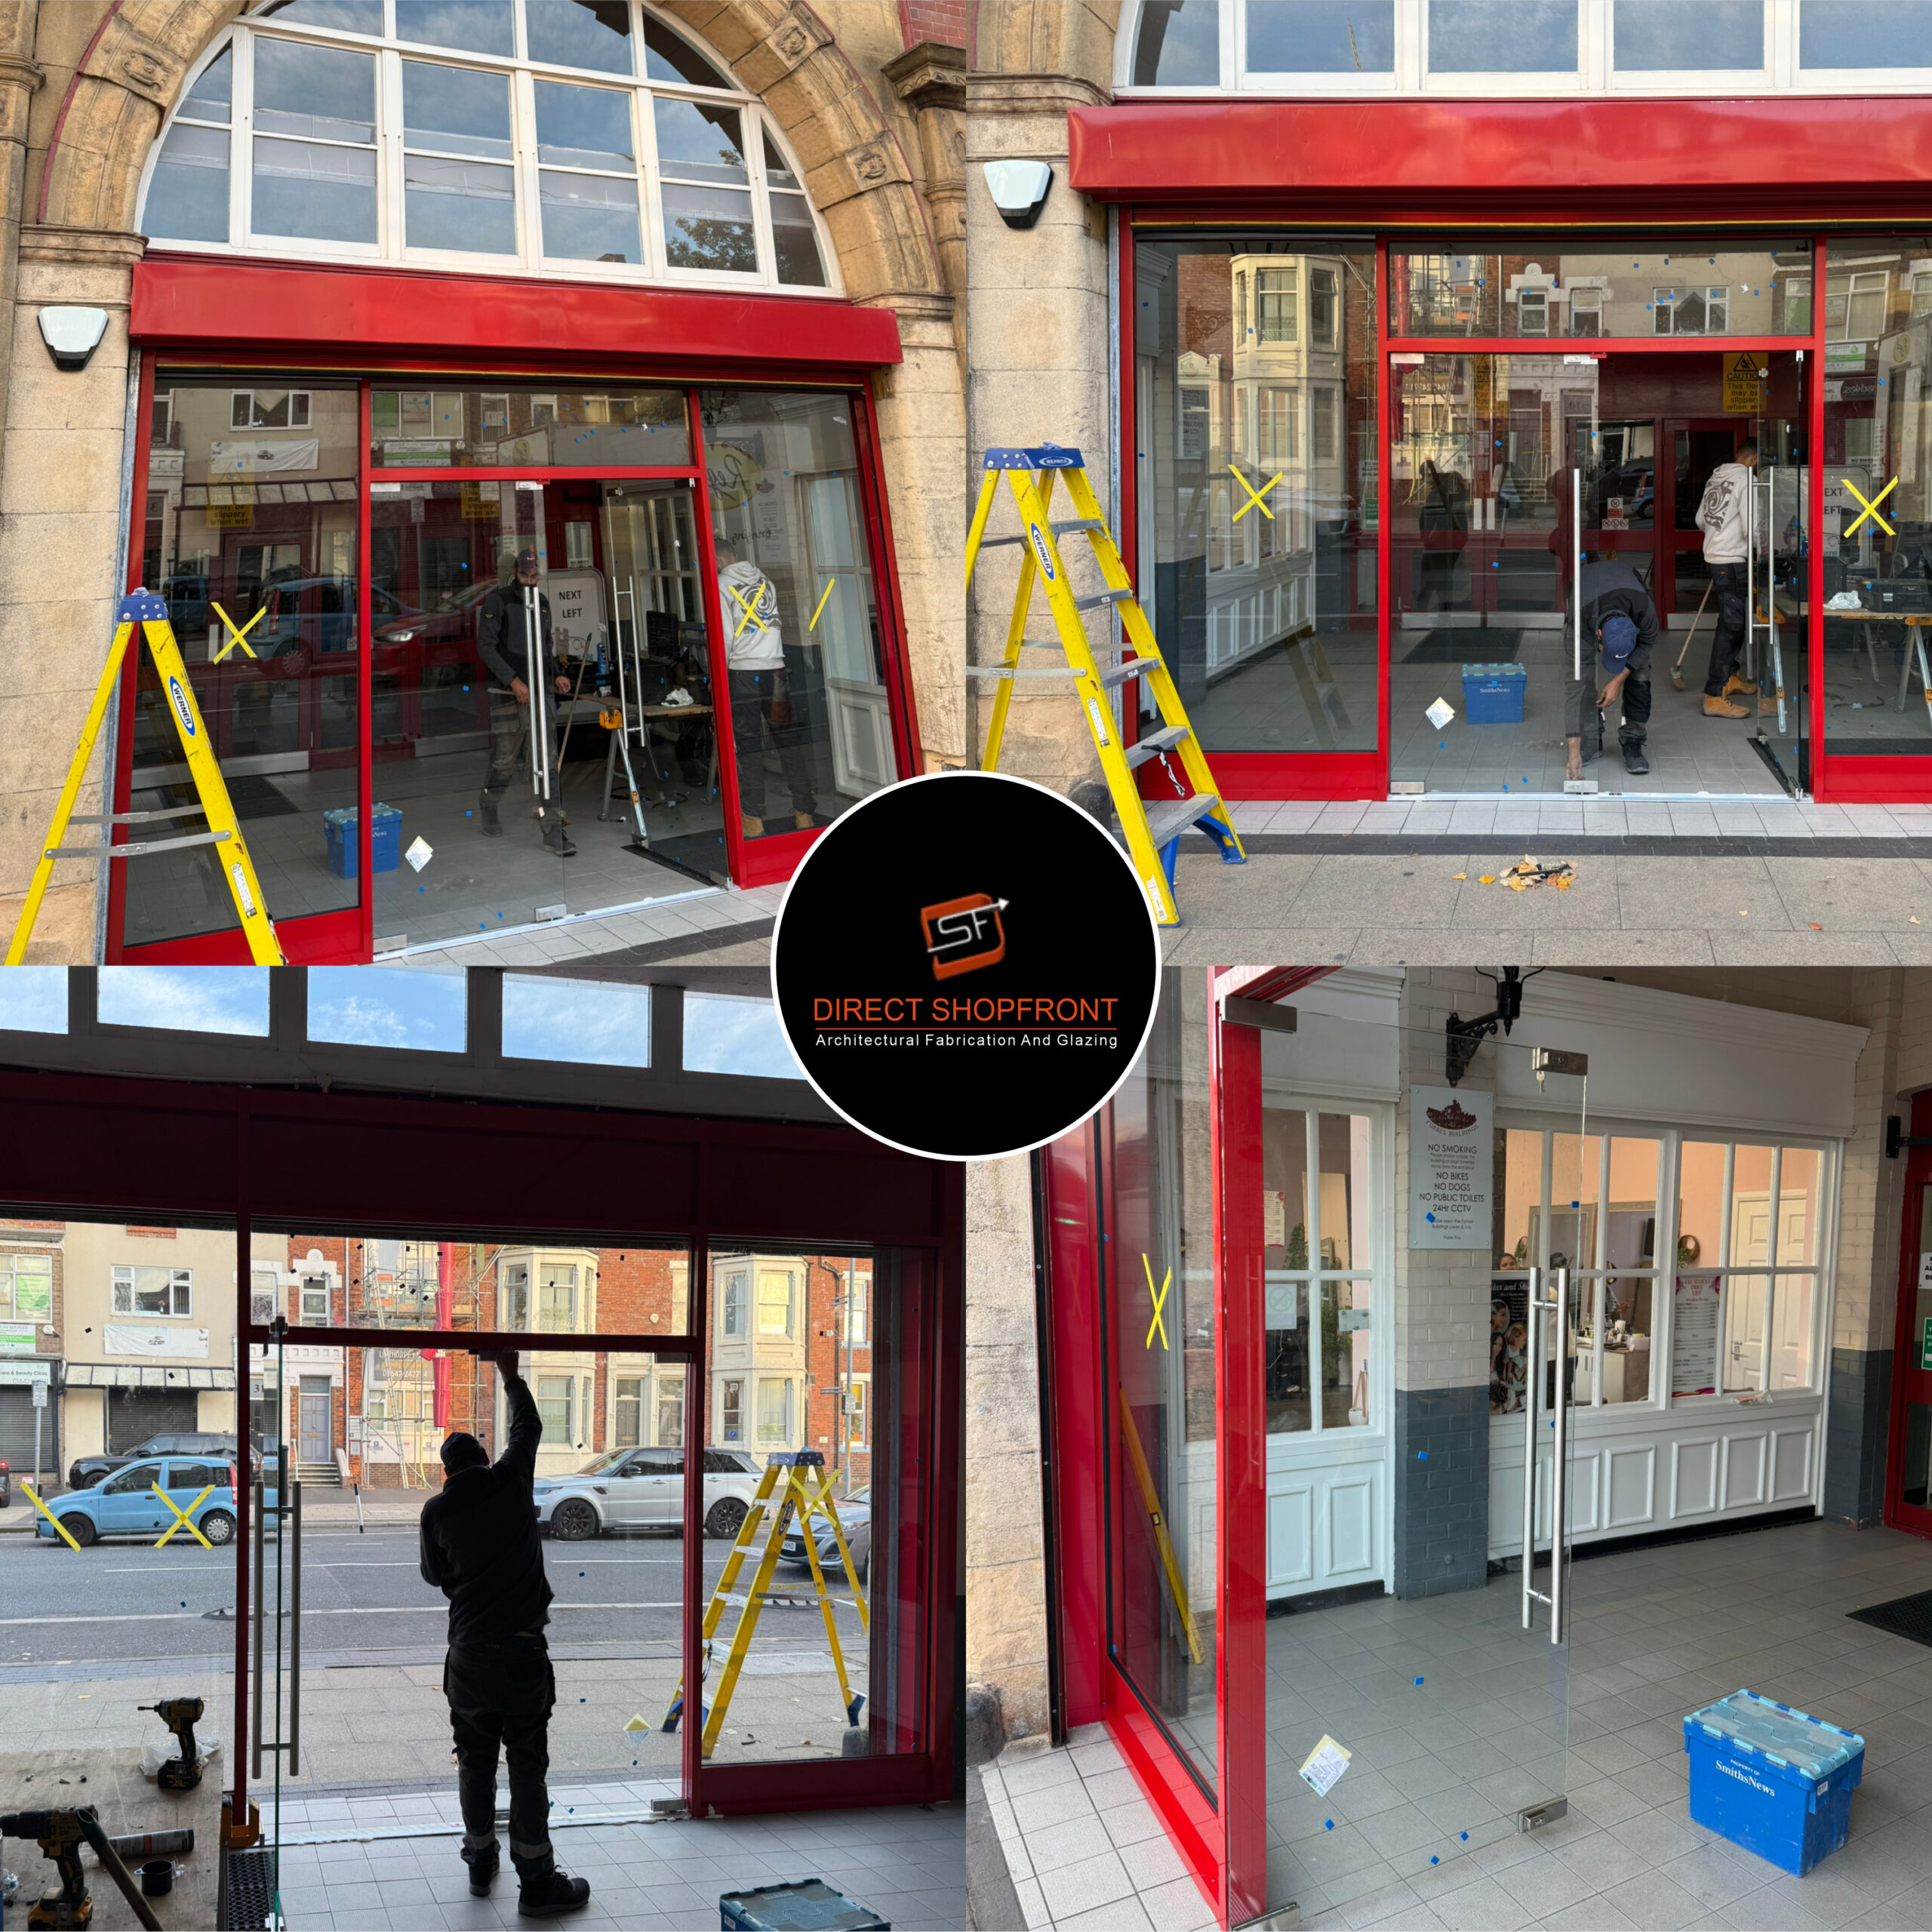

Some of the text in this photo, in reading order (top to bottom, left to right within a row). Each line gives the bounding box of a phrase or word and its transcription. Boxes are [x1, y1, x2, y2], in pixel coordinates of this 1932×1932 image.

[1824, 488, 1844, 497] EXT
[1034, 533, 1051, 570] WERNER
[558, 590, 583, 601] NEXT
[562, 608, 583, 619] LEFT
[173, 687, 192, 725] WERNER
[1426, 1120, 1479, 1137] FORBES BUILDINGS
[1428, 1143, 1478, 1154] NO SMOKING
[1448, 1183, 1471, 1192] DOGS
[1433, 1193, 1457, 1201] PUBLIC
[1460, 1194, 1484, 1202] TOILETS
[1432, 1204, 1449, 1212] 24Hr
[1730, 1759, 1754, 1772] PROPERTY
[1715, 1760, 1775, 1797] SmithsNews
